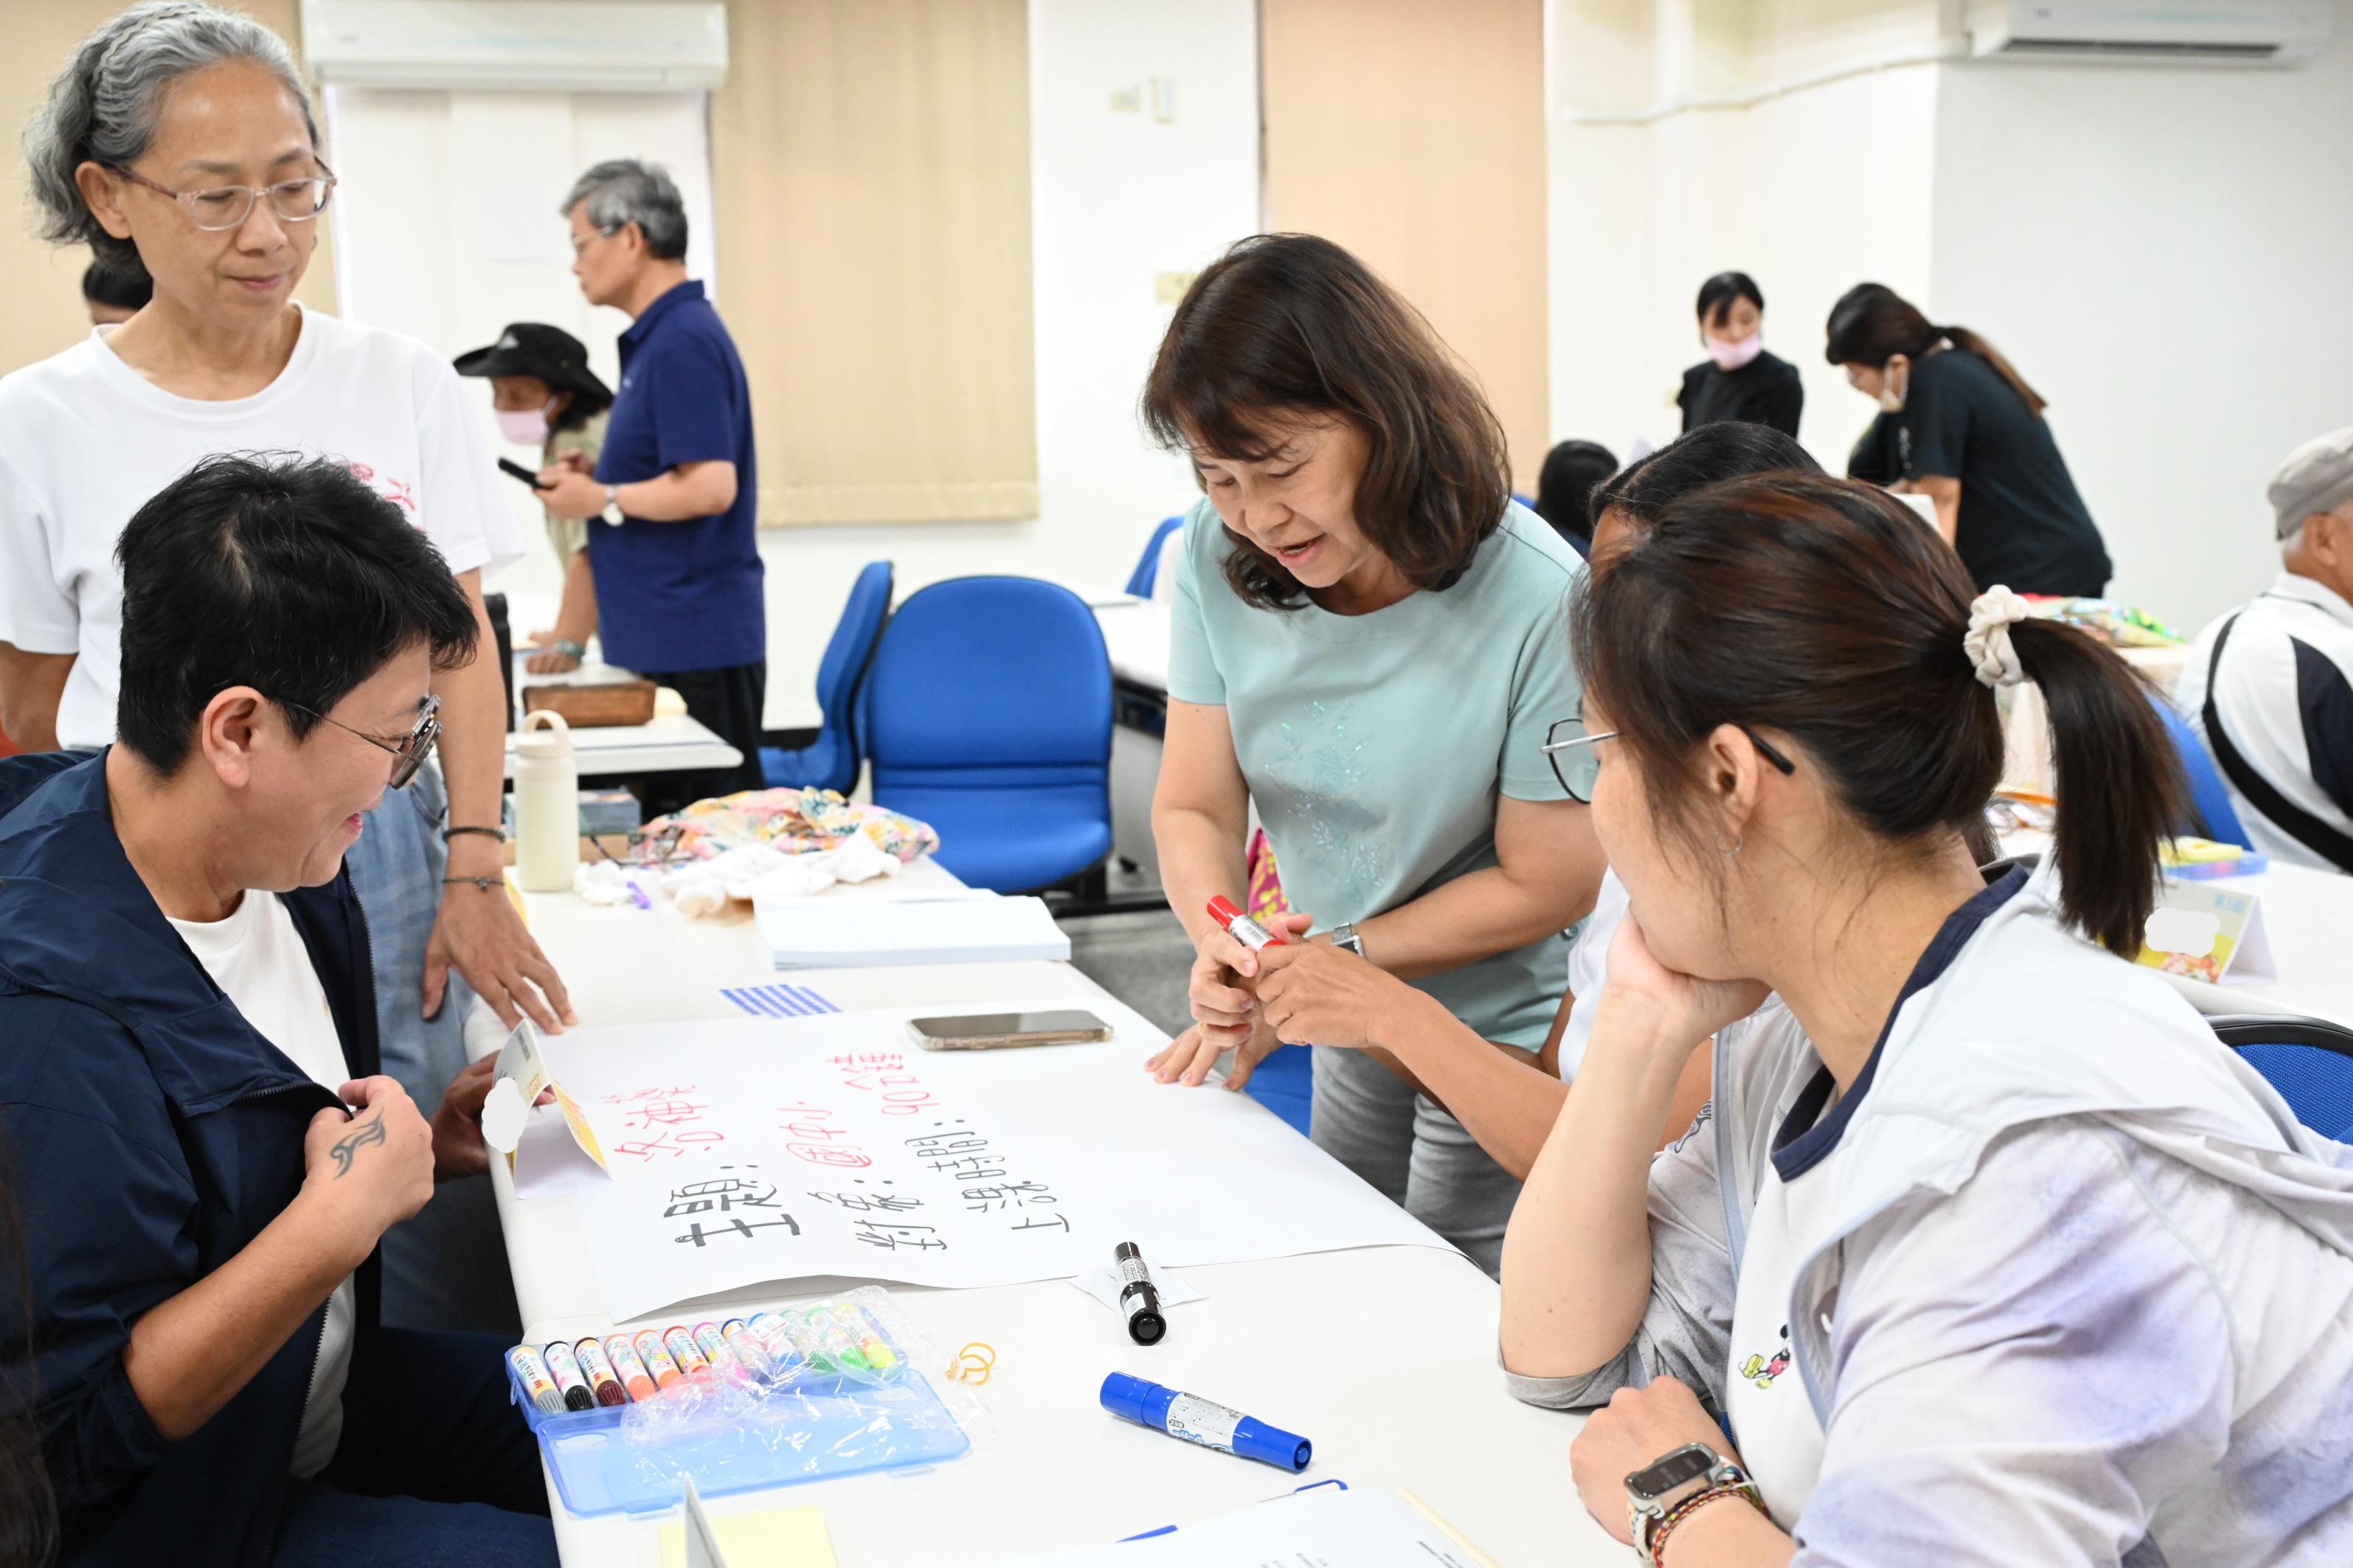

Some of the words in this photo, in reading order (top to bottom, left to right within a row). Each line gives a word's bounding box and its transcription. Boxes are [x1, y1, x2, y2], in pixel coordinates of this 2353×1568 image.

[825, 1051, 940, 1115] 90分鐘
[777, 1100, 873, 1169] 國中小
